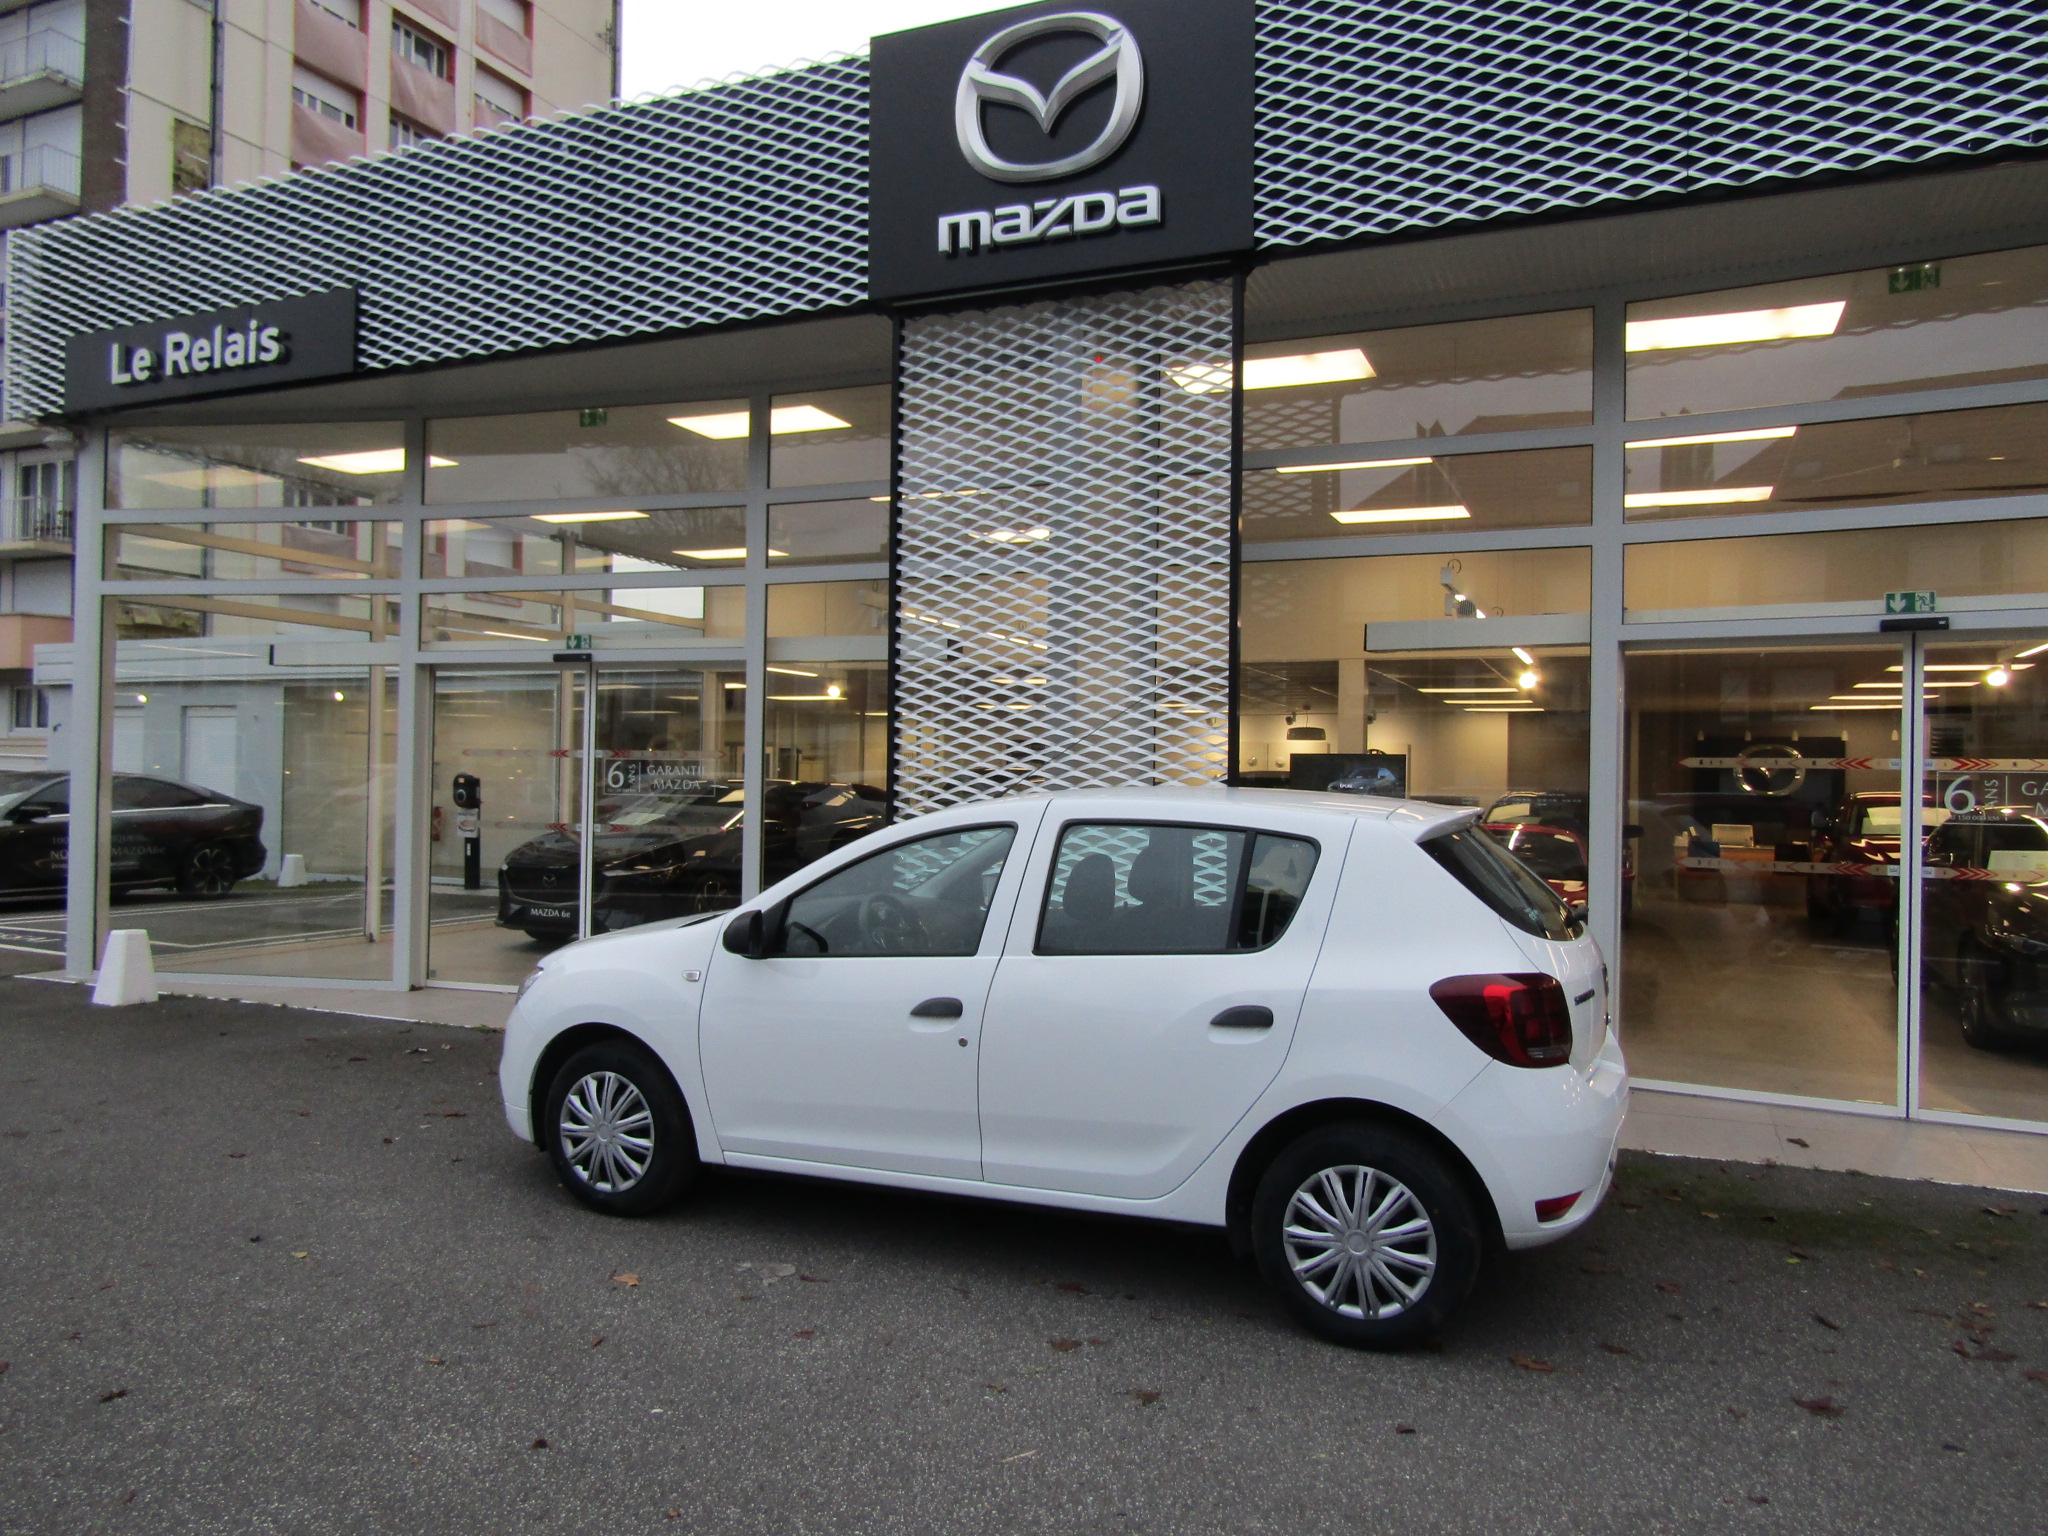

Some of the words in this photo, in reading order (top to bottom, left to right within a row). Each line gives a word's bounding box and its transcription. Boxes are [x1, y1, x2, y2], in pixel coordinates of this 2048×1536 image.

[111, 342, 152, 385] Le
[165, 319, 281, 377] Relais
[607, 761, 625, 788] 6
[628, 763, 636, 784] ANS
[653, 779, 701, 790] MAZDA
[1943, 774, 1976, 815] 6
[530, 907, 560, 917] MAZDA
[561, 909, 571, 918] 6e
